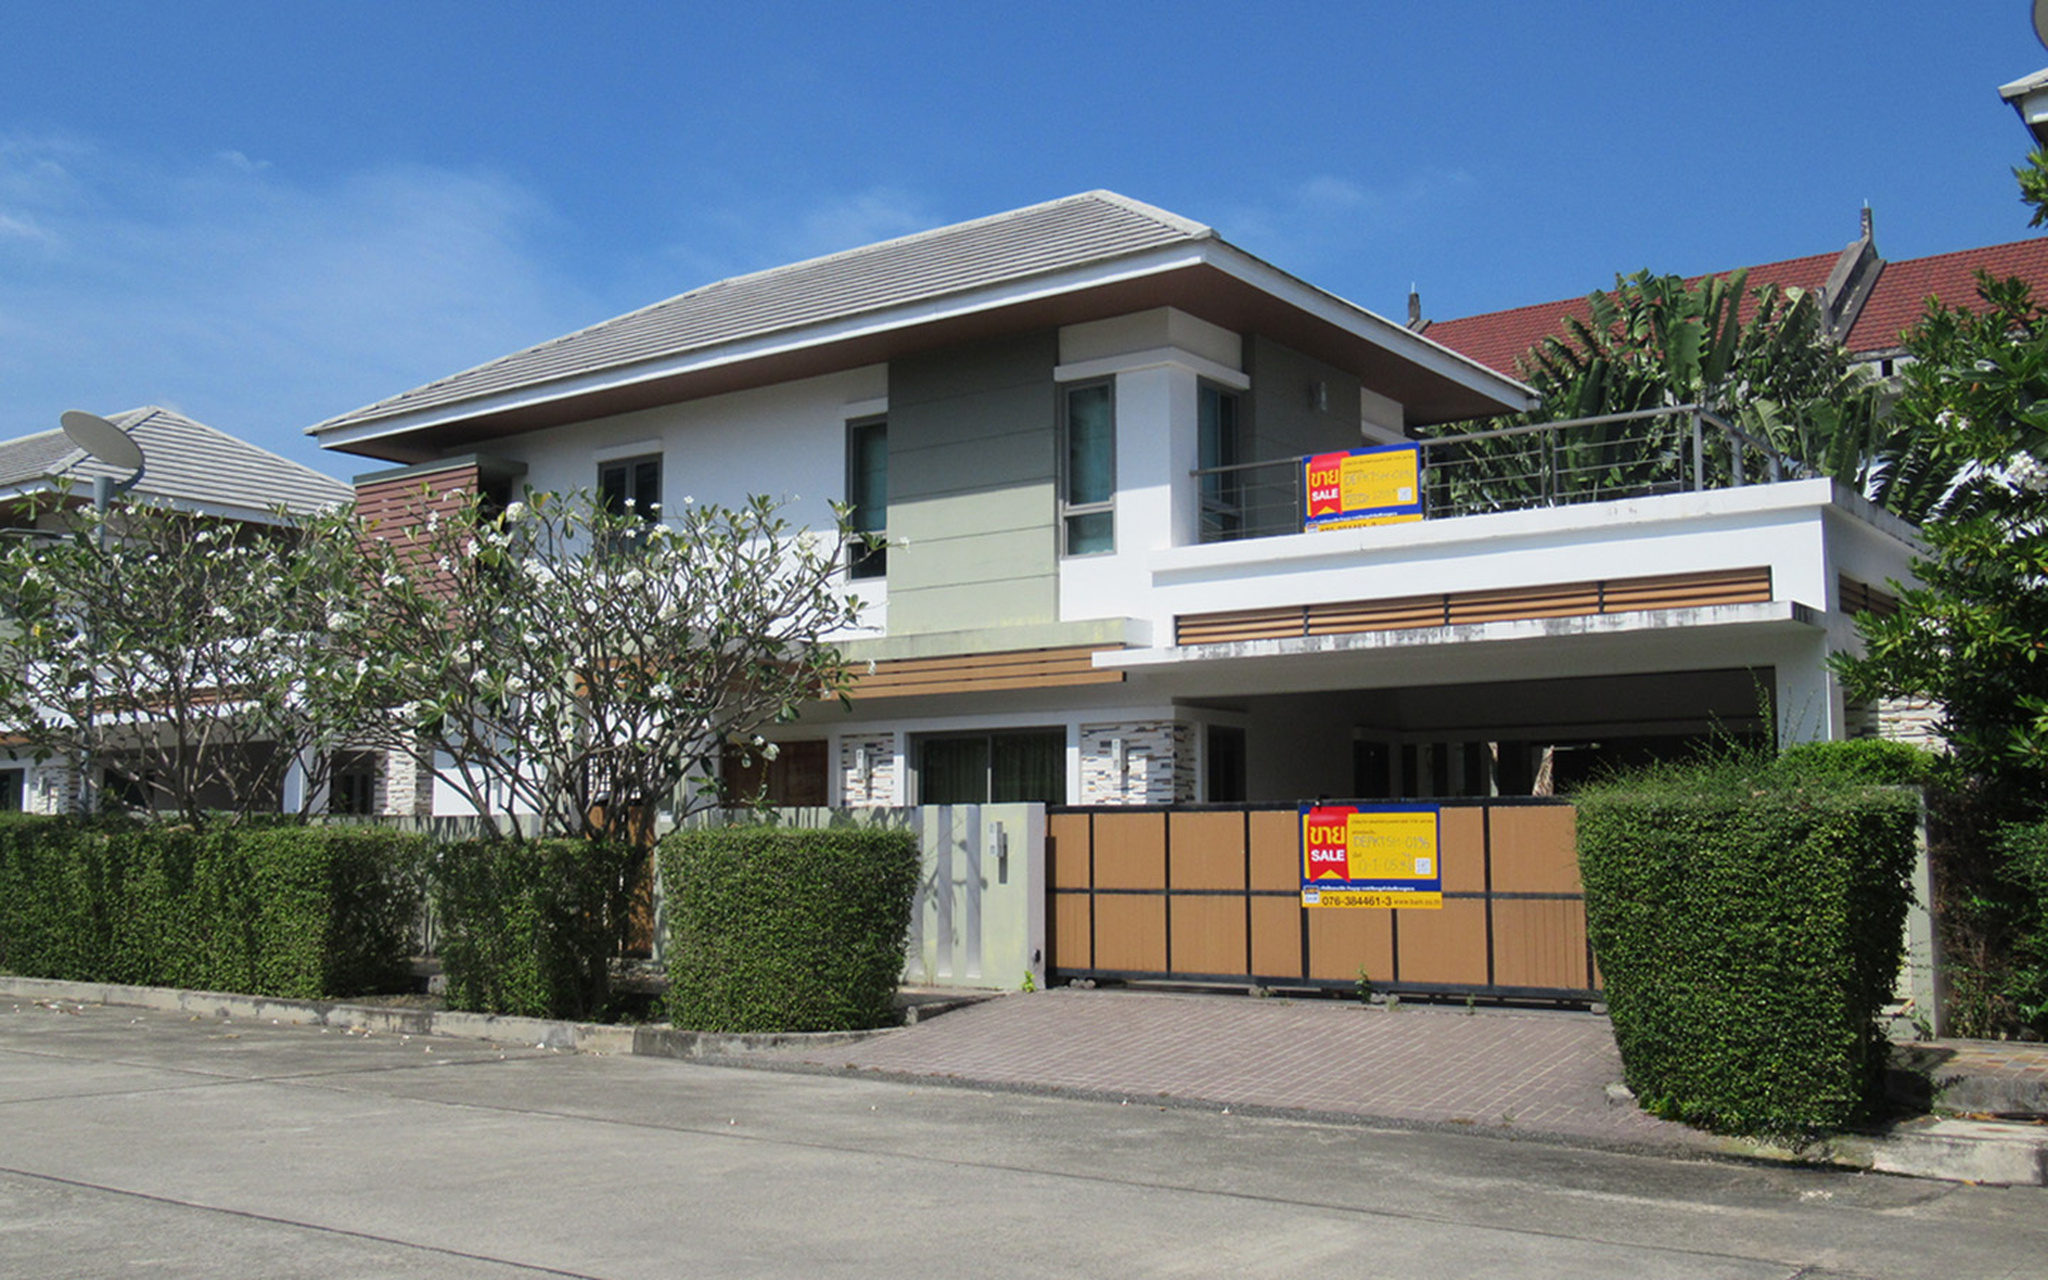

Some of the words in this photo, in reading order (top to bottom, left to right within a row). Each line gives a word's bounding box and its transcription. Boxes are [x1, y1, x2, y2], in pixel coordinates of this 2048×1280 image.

[1311, 468, 1340, 487] ขาย
[1311, 488, 1339, 502] SALE
[1310, 826, 1346, 845] ขาย
[1310, 849, 1346, 862] SALE
[1321, 895, 1393, 907] 076-384461-3
